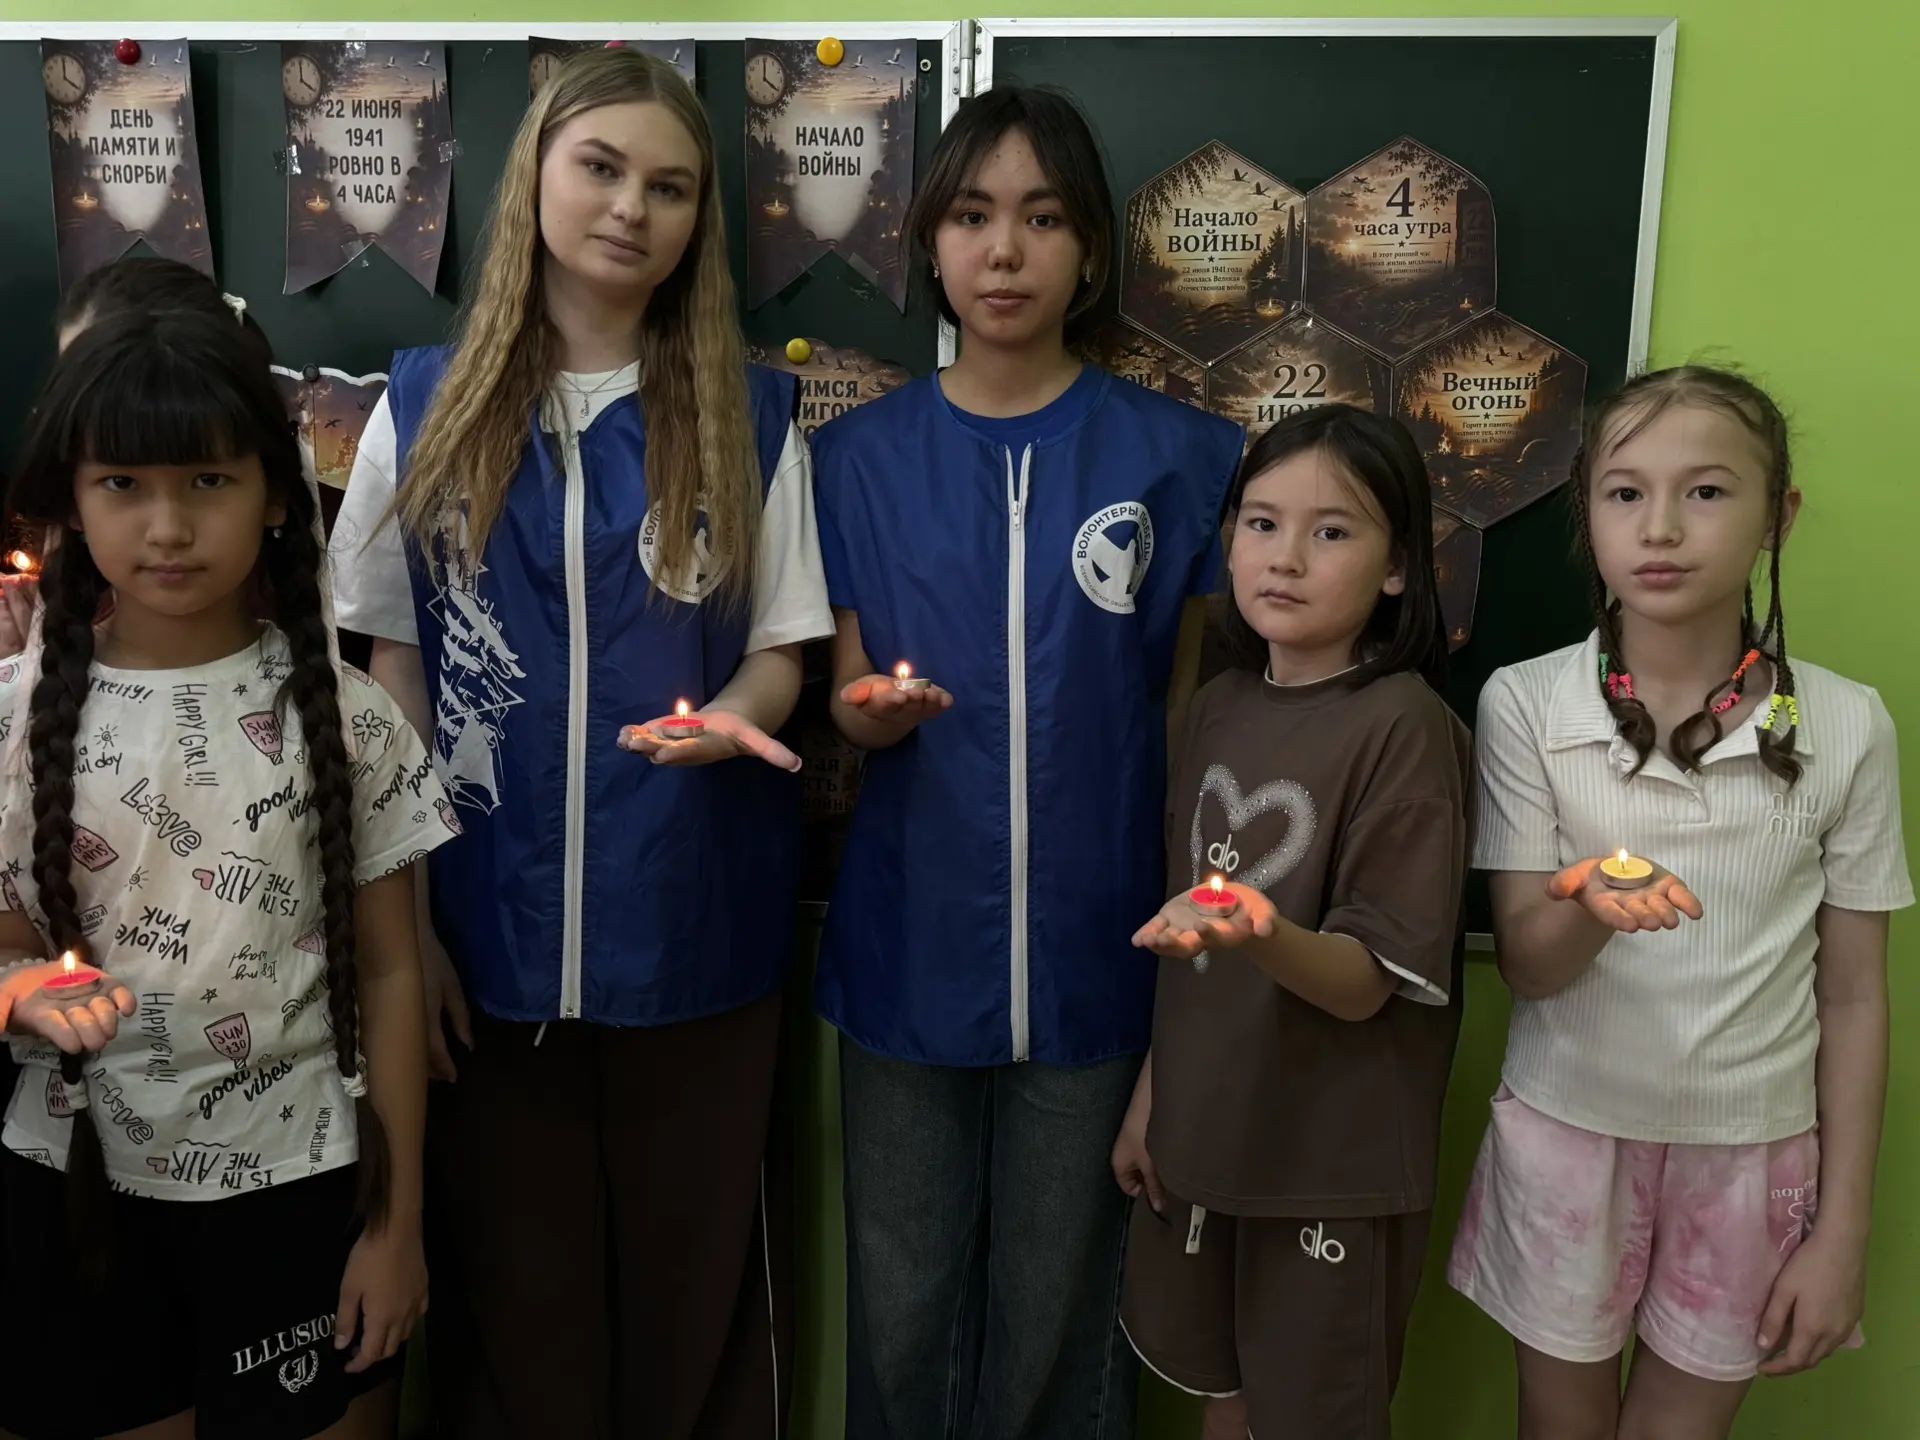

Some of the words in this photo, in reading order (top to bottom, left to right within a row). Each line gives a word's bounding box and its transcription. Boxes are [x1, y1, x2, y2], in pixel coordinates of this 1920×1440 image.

[110, 109, 154, 130] ДЕНЬ
[325, 99, 345, 120] 22
[351, 98, 402, 120] ИЮНЯ
[88, 136, 160, 157] ПАМЯТИ
[165, 135, 176, 156] И
[345, 127, 383, 148] 1941
[795, 126, 864, 148] НАЧАЛО
[102, 164, 167, 185] СКОРБИ
[328, 156, 384, 177] РОВНО
[391, 155, 402, 176] В
[798, 150, 862, 177] ВОЙНЫ
[336, 185, 347, 204] 4
[353, 184, 396, 205] ЧАСА
[1386, 177, 1415, 217] 4
[1173, 208, 1258, 228] Начало
[1355, 222, 1399, 236] часа
[1405, 221, 1451, 239] утра
[1211, 265, 1226, 273] 1941
[1272, 362, 1327, 399] 22
[1441, 372, 1539, 392] Вечный
[1077, 506, 1138, 559] ВОЛОНТЕРЫ
[215, 864, 263, 905] AIR
[264, 873, 295, 896] THE
[212, 1023, 245, 1045] SUN
[171, 1150, 220, 1186] AIR
[225, 1152, 261, 1171] THE
